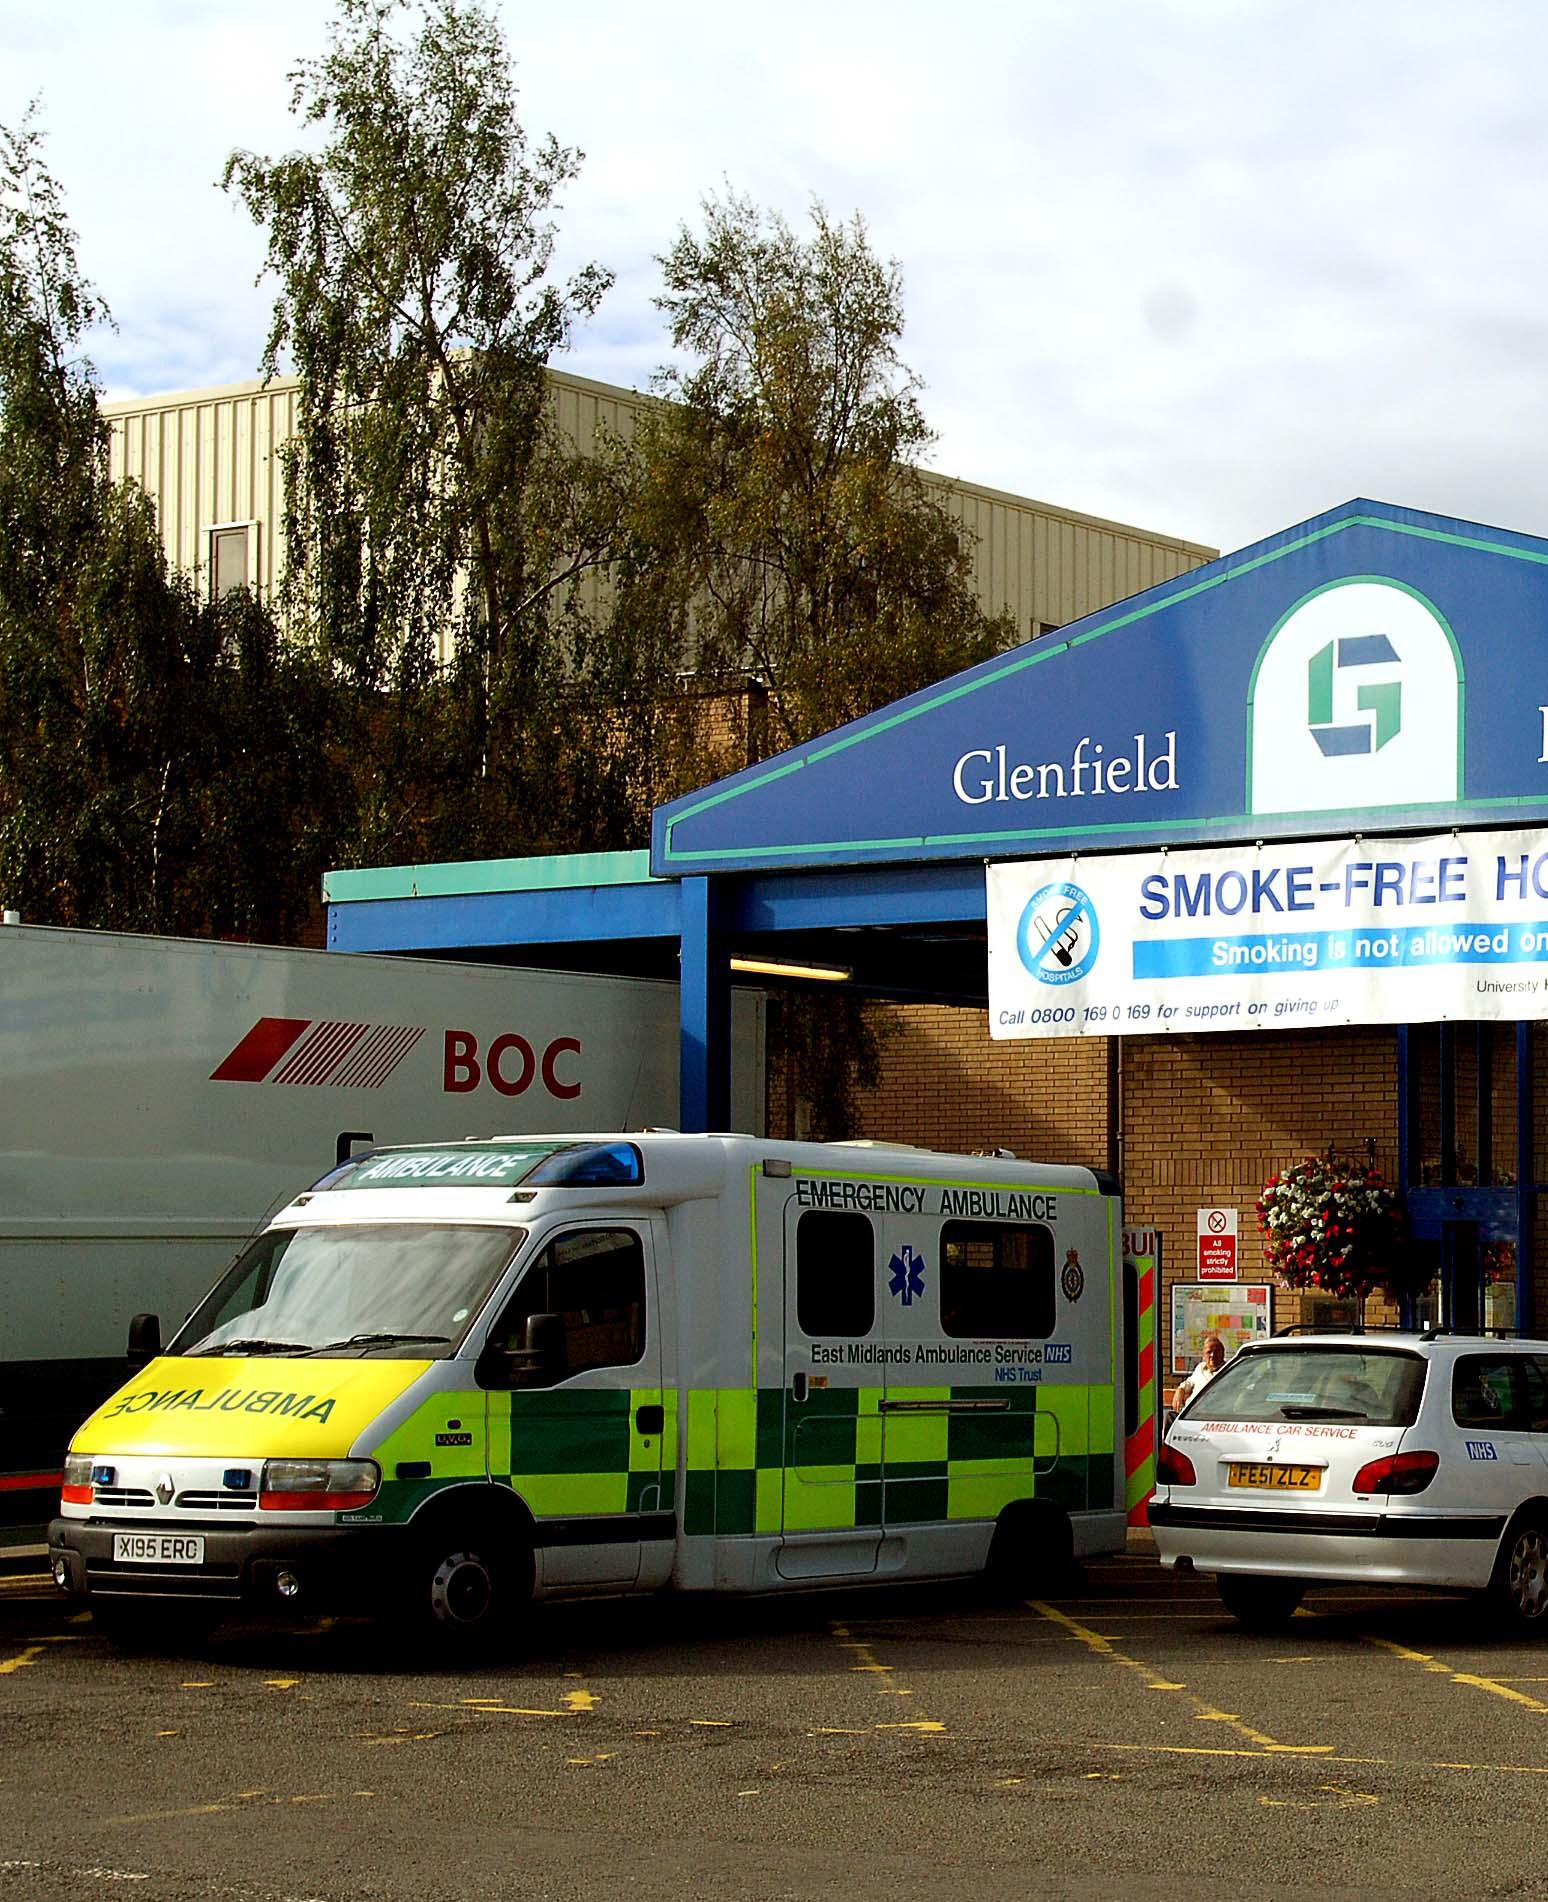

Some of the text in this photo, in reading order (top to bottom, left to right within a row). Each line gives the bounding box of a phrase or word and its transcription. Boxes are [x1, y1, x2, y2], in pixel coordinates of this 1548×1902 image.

[953, 731, 1180, 805] Glenfield
[1064, 886, 1088, 905] FREE
[1139, 857, 1469, 920] SMOKE-FREE
[1212, 938, 1318, 966] Smoking
[1328, 935, 1345, 960] is
[1355, 937, 1399, 958] not
[1410, 928, 1509, 957] allowed
[1476, 979, 1539, 994] University
[999, 1007, 1025, 1026] Call
[1031, 1007, 1076, 1024] 0800
[1083, 1005, 1107, 1022] 169
[1127, 1003, 1151, 1020] 169
[1157, 1002, 1179, 1018] for
[1185, 1001, 1241, 1020] support
[1248, 1001, 1268, 1015] on
[1274, 998, 1318, 1017] giving
[1323, 999, 1339, 1014] up
[444, 1029, 582, 1100] BOC
[358, 1154, 529, 1181] AMBULANCE
[795, 1180, 1058, 1221] EMERGENCY AMBULANCE
[1203, 1249, 1232, 1258] smoking
[1206, 1258, 1229, 1267] strictly
[1201, 1266, 1234, 1275] prohibited
[811, 1344, 1072, 1364] East Midlands Ambulance Service NHS
[995, 1367, 1042, 1382] NHS Trust
[1200, 1423, 1359, 1440] AMBULANCE CAR SERVICE
[1466, 1441, 1497, 1460] NHS
[1238, 1463, 1311, 1487] FE51 ZLZ
[120, 1537, 157, 1558] X195
